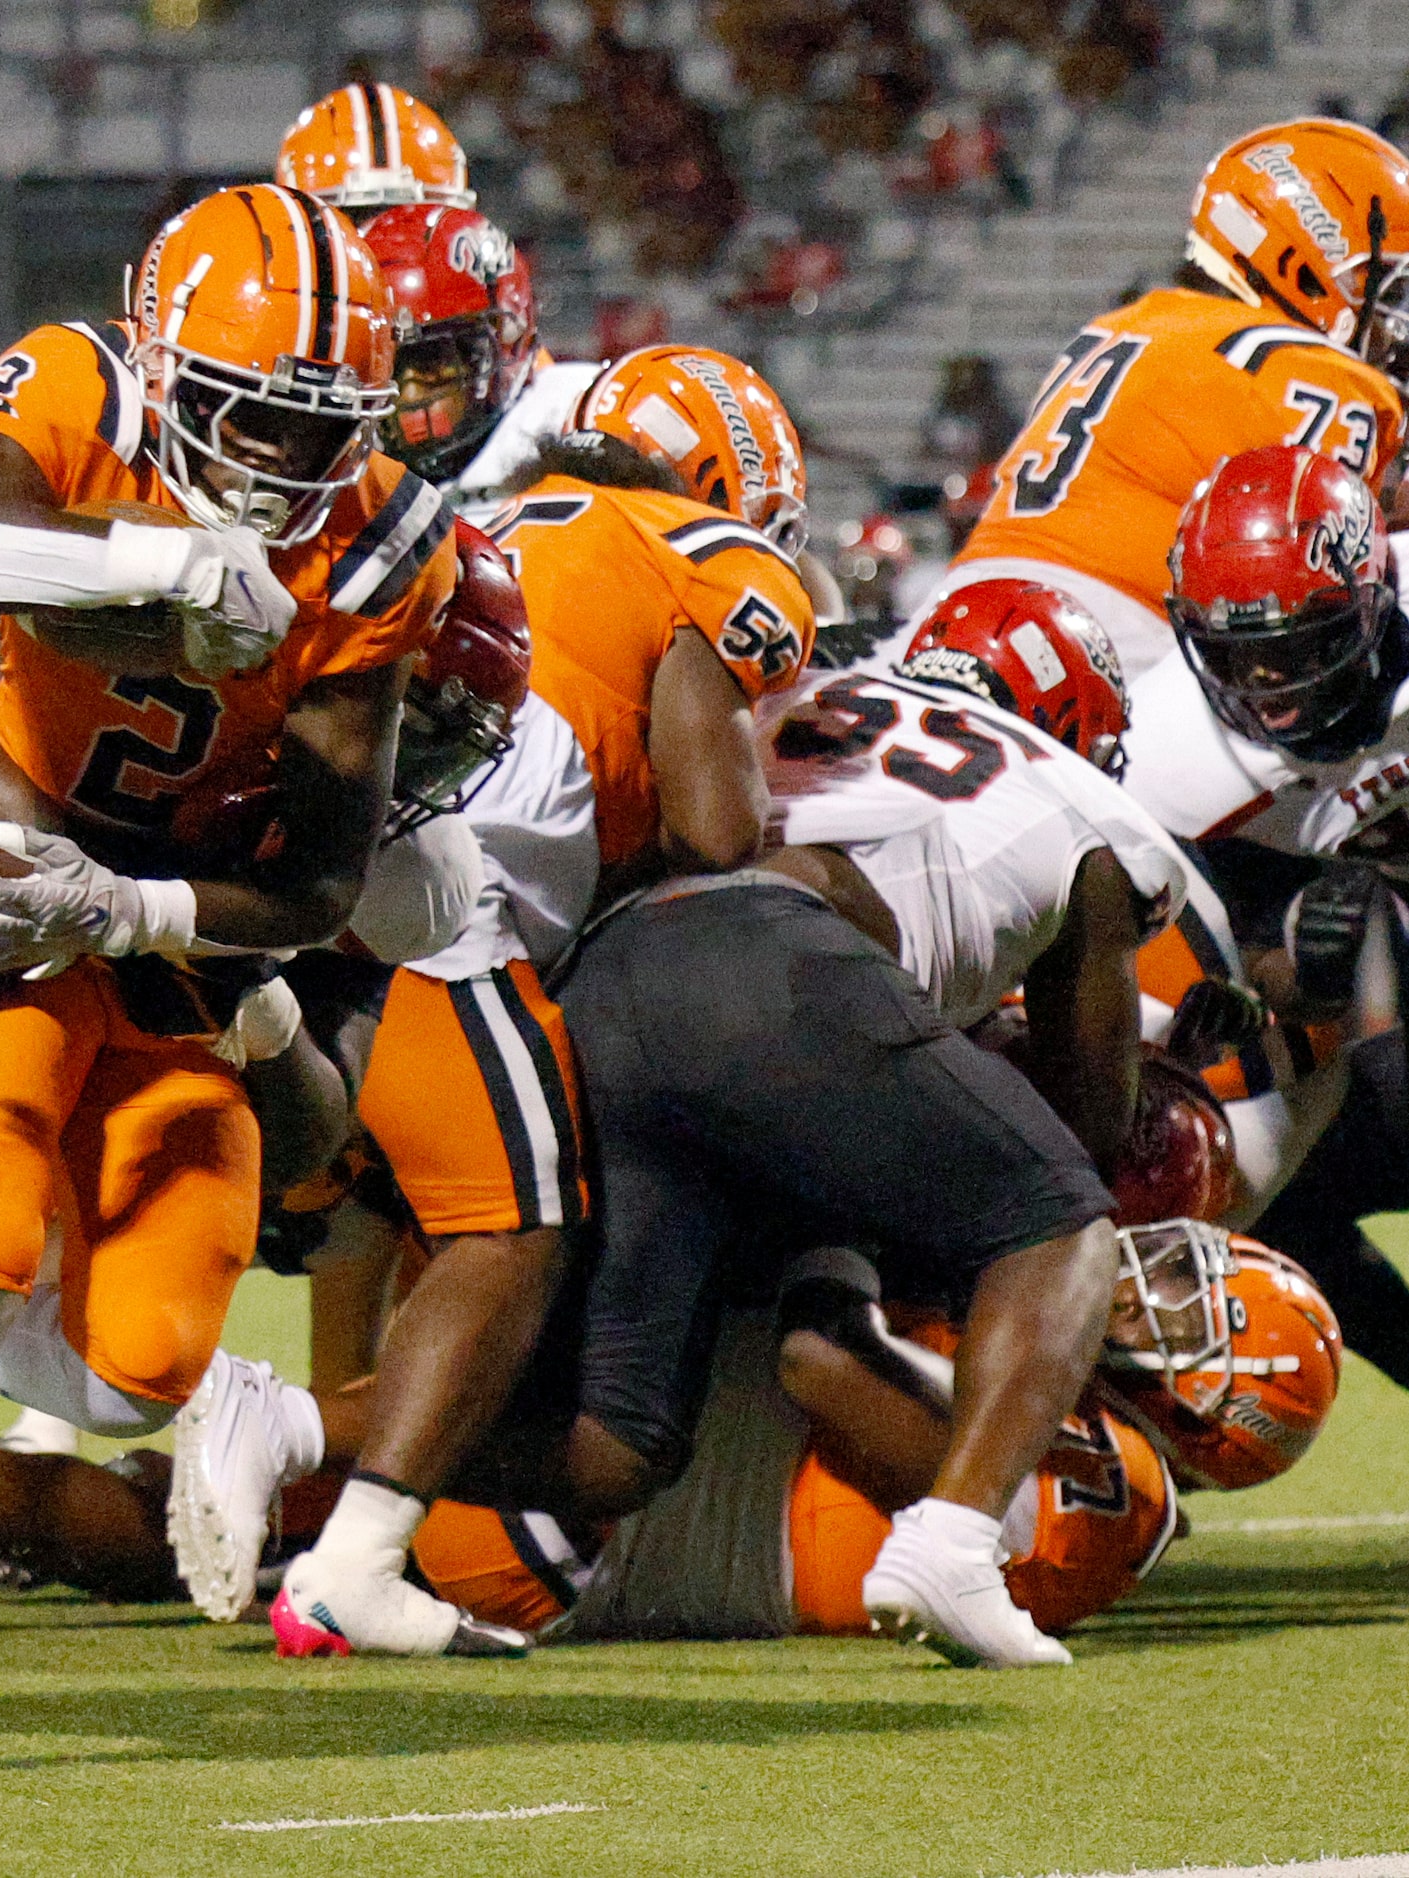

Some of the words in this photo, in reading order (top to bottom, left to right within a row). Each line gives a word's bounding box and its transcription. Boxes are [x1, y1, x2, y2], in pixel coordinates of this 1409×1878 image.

[1243, 143, 1349, 262] Lanaster
[670, 356, 768, 496] Lancaster
[1282, 378, 1377, 477] 73
[64, 673, 226, 832] 2
